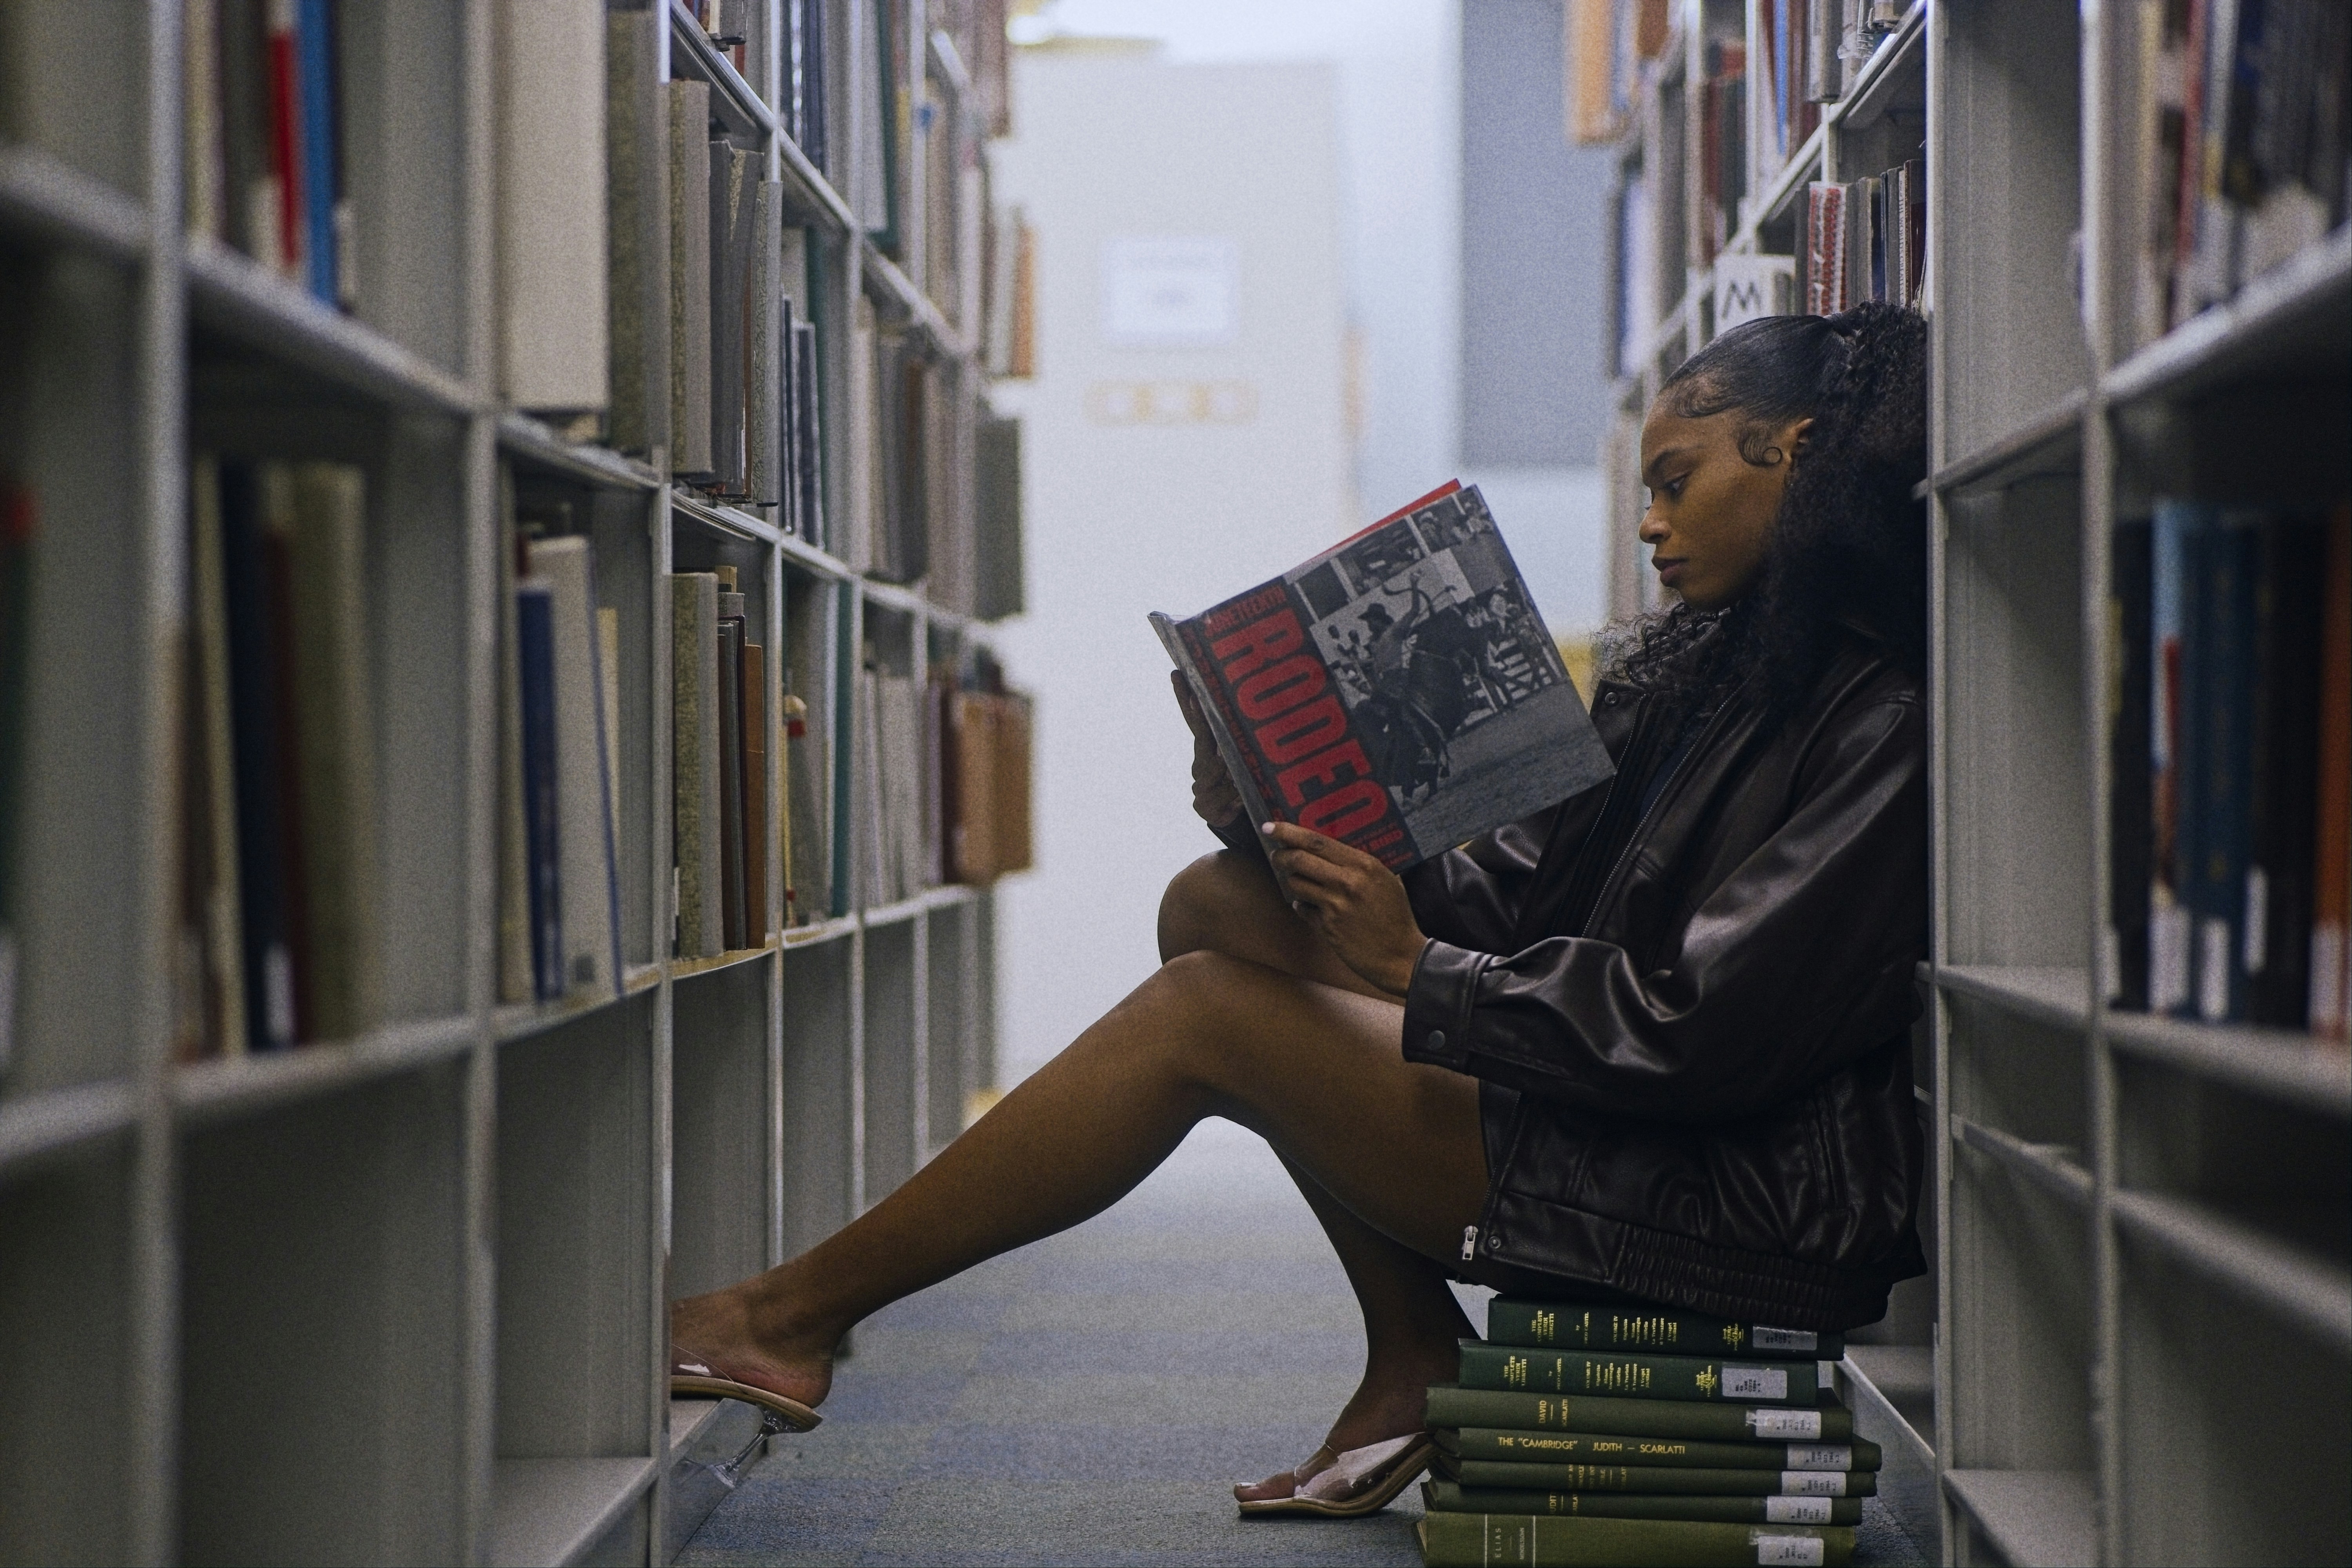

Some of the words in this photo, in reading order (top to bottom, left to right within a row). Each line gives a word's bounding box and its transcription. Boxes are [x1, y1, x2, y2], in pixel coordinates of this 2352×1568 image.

[1210, 606, 1388, 841] RODEO
[1498, 1437, 1514, 1446] THE
[1593, 1442, 1622, 1452] JUDITH
[1640, 1444, 1685, 1454] SCARLATTI
